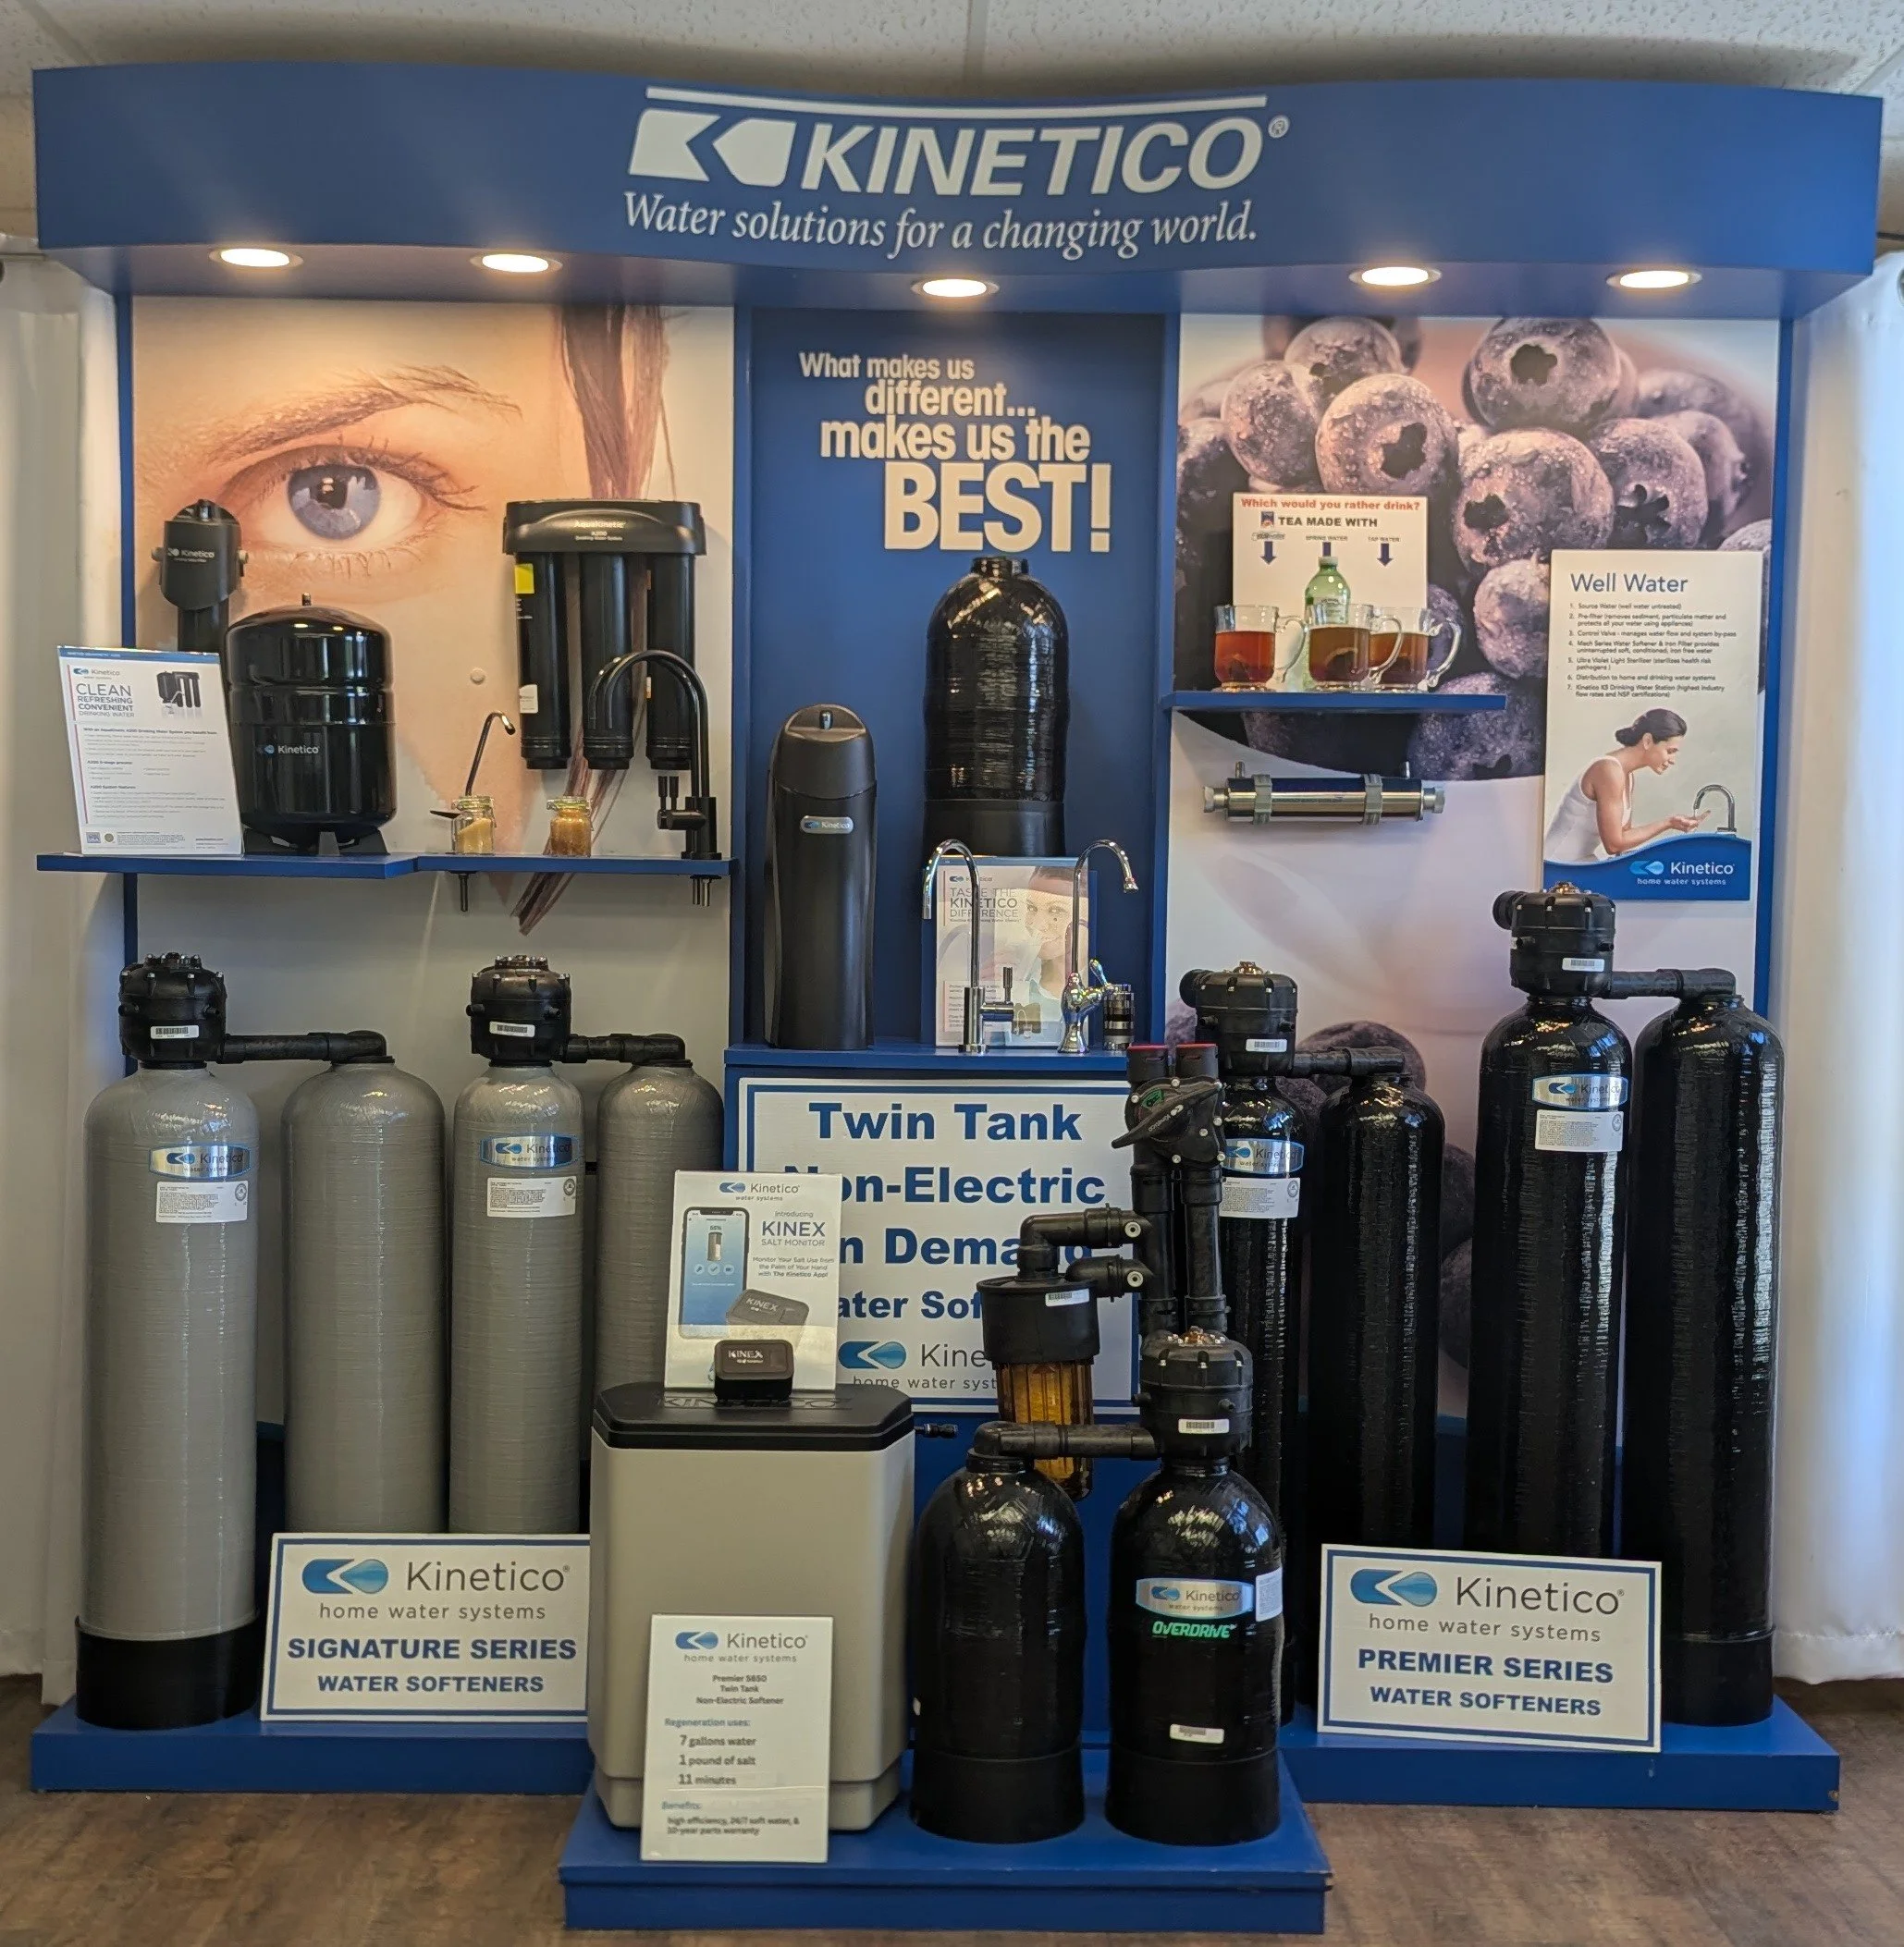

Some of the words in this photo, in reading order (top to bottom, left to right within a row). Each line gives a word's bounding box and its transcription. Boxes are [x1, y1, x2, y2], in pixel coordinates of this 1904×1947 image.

[623, 192, 725, 235] Water
[733, 201, 885, 246] solutions
[888, 209, 941, 258] for
[952, 220, 973, 248] a
[983, 210, 1143, 260] changing
[1150, 202, 1257, 244] world.
[799, 352, 861, 377] What
[867, 354, 940, 380] makes
[947, 359, 975, 380] us
[865, 379, 1036, 416] different...
[821, 416, 956, 459] makes
[967, 423, 1015, 460] us
[1026, 416, 1090, 461] the
[884, 461, 1112, 553] BEST!
[1241, 498, 1277, 508] Which
[1281, 498, 1316, 509] would
[1321, 501, 1341, 510] you
[1345, 500, 1380, 509] rather
[1383, 501, 1419, 511] drink?
[1278, 517, 1303, 526] TEA
[1307, 517, 1341, 526] MADE
[1345, 518, 1378, 527] WITH
[1570, 572, 1616, 593] Well
[1623, 573, 1688, 593] Water
[76, 683, 131, 696] CLEAN
[278, 744, 319, 754] Kinetico
[1670, 862, 1734, 875] Kinetico
[950, 888, 987, 897] TASE
[993, 888, 1017, 897] THE
[1581, 1084, 1620, 1093] Kinetco
[809, 1102, 935, 1140] Twin
[954, 1104, 1083, 1141] Tank
[1256, 1148, 1296, 1158] Kinetco
[751, 1183, 799, 1194] Kinetico
[762, 1221, 825, 1236] KINEX
[885, 1228, 1091, 1264] Dema
[745, 1298, 779, 1312] KINEX
[728, 1350, 764, 1358] KINEX
[921, 1343, 986, 1367] Kine
[908, 1378, 955, 1389] water
[964, 1378, 997, 1390] syst
[1185, 1590, 1239, 1601] Kinetico
[320, 1603, 378, 1620] home
[389, 1604, 449, 1620] water
[459, 1603, 546, 1622] systems
[1152, 1622, 1231, 1638] OVERDRIVE
[1370, 1613, 1429, 1633] home
[1439, 1618, 1501, 1636] water
[1510, 1622, 1602, 1642] systems
[727, 1633, 807, 1649] Kinetico
[288, 1638, 460, 1659] SIGNATURE
[470, 1638, 577, 1660] SERIES
[684, 1654, 714, 1662] home
[719, 1654, 748, 1662] water
[753, 1654, 797, 1663] systems
[1358, 1648, 1493, 1676] PREMIER
[1504, 1657, 1614, 1684] SERIES
[317, 1675, 399, 1692] WATER
[406, 1676, 544, 1692] SOFTENERS
[1370, 1686, 1452, 1707] WATER
[1459, 1693, 1602, 1716] SOFTENERS
[665, 1718, 725, 1728] Regeneration
[680, 1734, 687, 1745] 7
[689, 1737, 725, 1747] gallons
[679, 1755, 686, 1765] 1
[689, 1757, 721, 1766] pound
[724, 1757, 735, 1765] of
[737, 1757, 755, 1765] salt
[679, 1774, 693, 1784] 11
[695, 1776, 737, 1784] minutes
[668, 1817, 684, 1826] high
[687, 1817, 727, 1825] efficiency,
[724, 1828, 760, 1836] warranty
